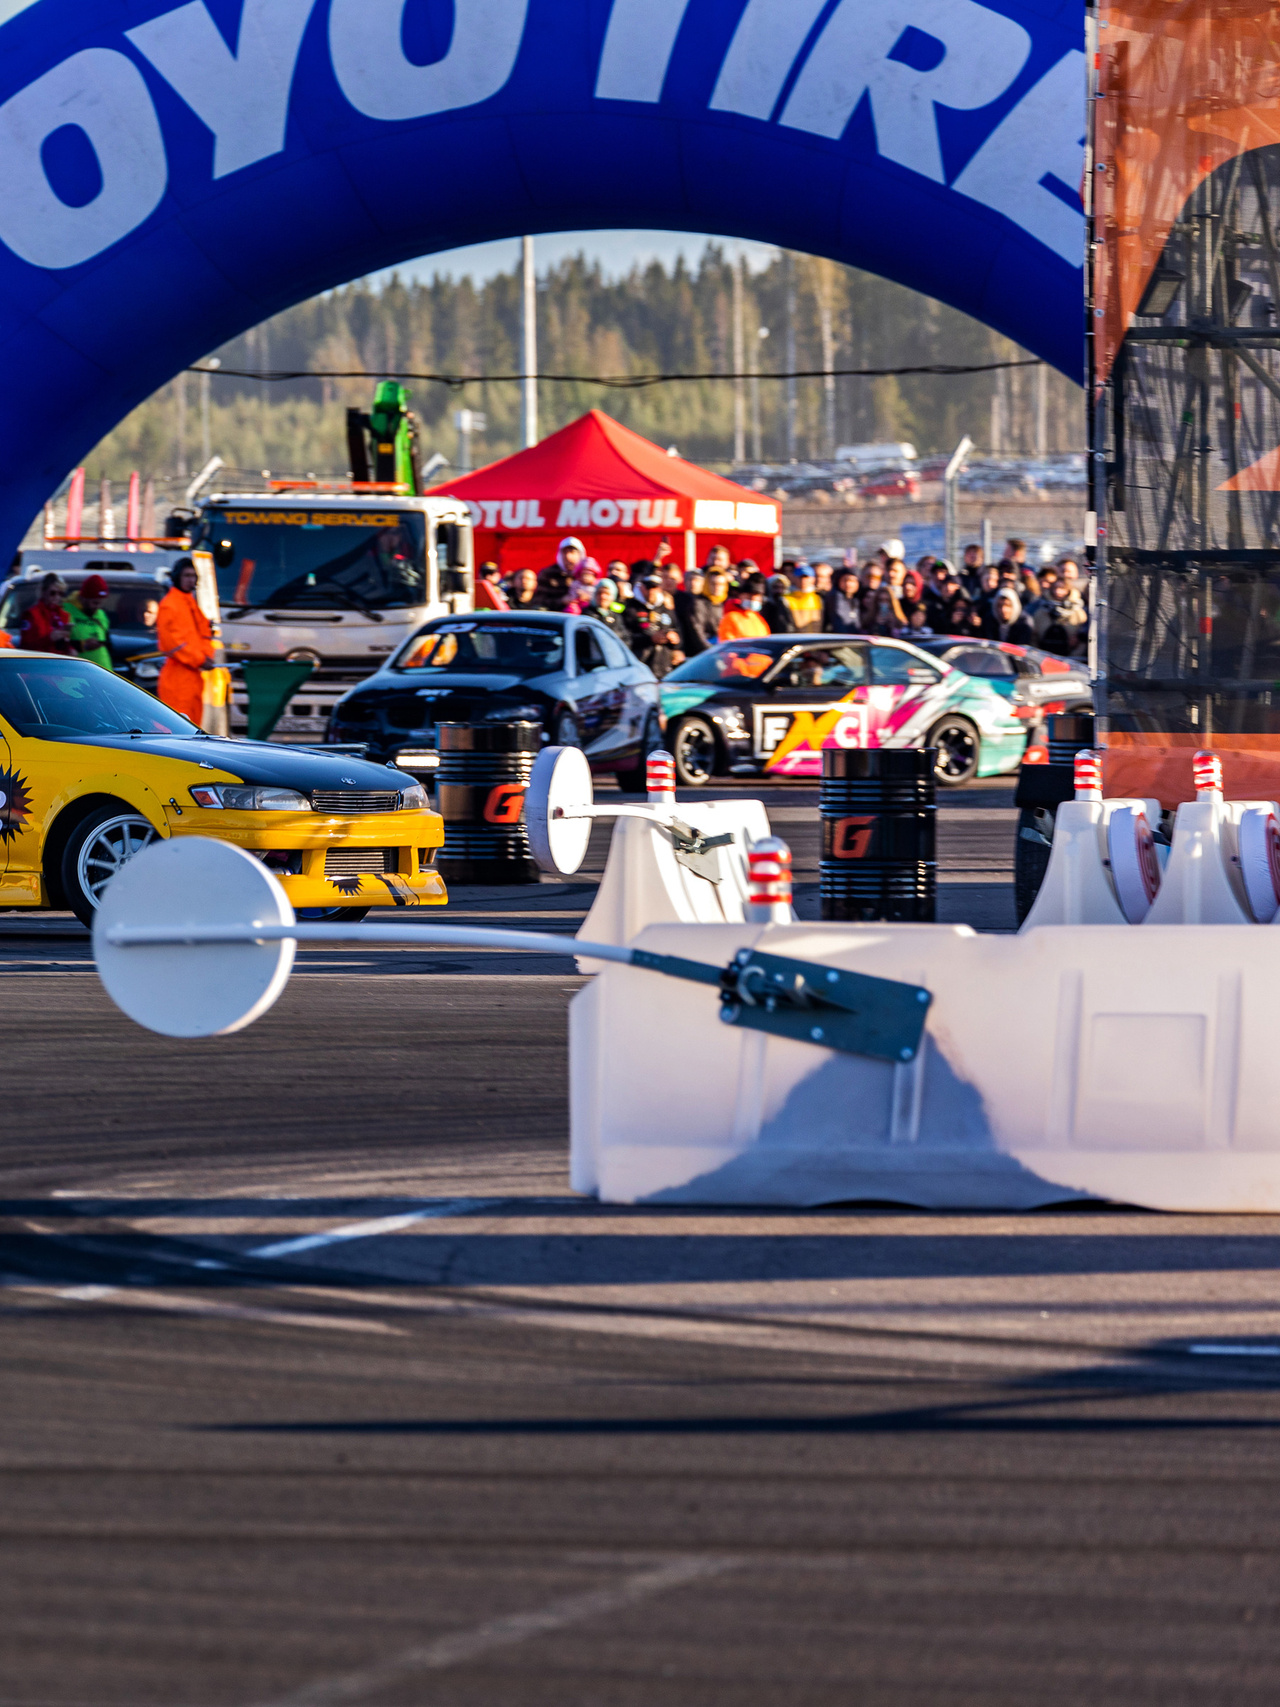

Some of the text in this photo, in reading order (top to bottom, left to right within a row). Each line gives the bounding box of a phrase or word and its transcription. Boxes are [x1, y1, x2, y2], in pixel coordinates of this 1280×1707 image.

[223, 511, 400, 527] TOWING SERVICE
[556, 499, 683, 528] MOTUL
[483, 784, 526, 823] G
[833, 816, 877, 858] G
